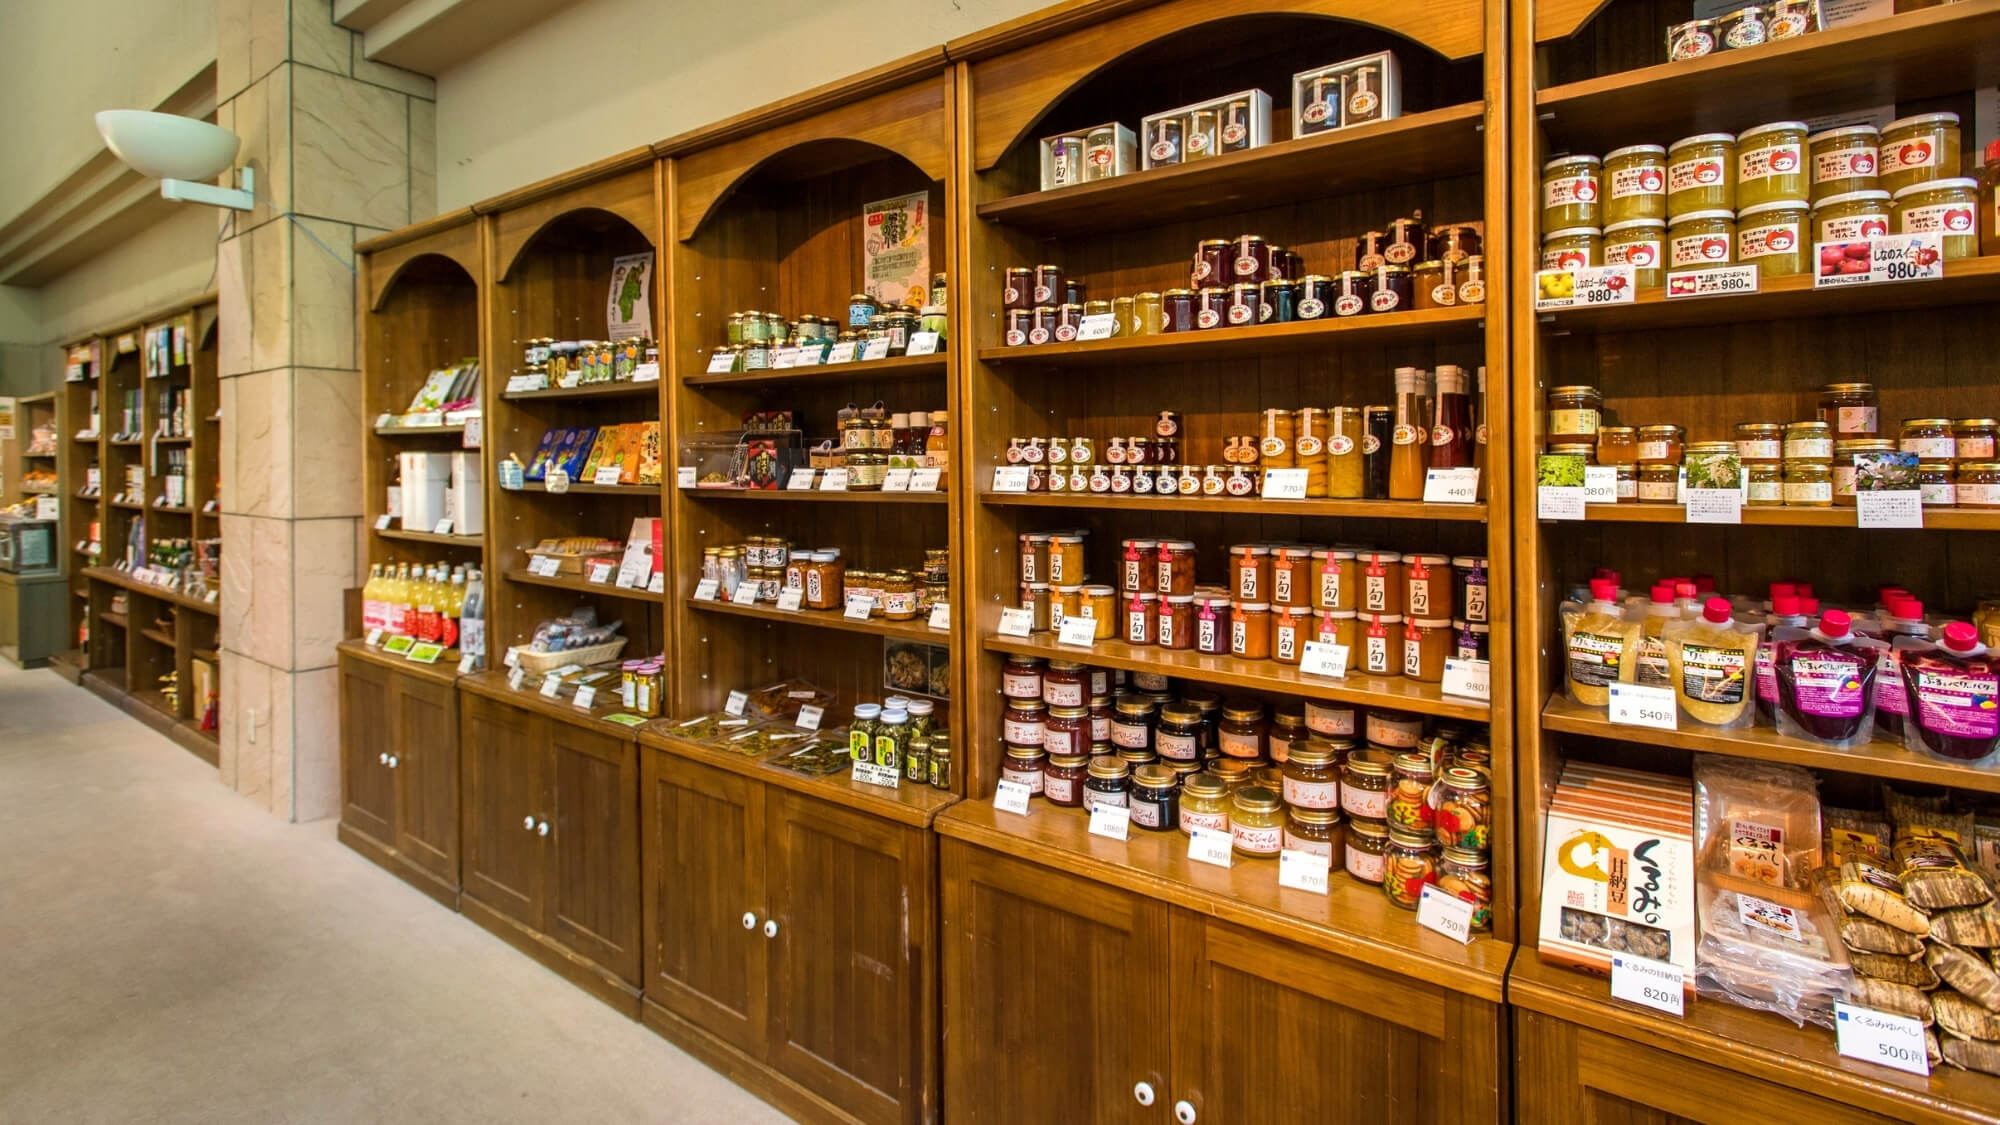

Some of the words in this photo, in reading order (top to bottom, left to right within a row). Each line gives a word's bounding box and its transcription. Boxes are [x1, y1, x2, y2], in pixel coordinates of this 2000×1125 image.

[1056, 166, 1065, 177] 旬
[1584, 486, 1614, 497] 080円
[1128, 570, 1139, 584] 旬
[1160, 572, 1171, 586] 旬
[1243, 578, 1256, 591] 旬
[1278, 581, 1290, 594] 旬
[1324, 586, 1338, 600] 旬
[1369, 588, 1384, 604] 旬
[1412, 592, 1427, 608] 旬
[1468, 598, 1485, 614] 旬
[1132, 621, 1144, 636] 旬
[1201, 630, 1214, 645] 旬
[1281, 638, 1293, 652] 旬
[1370, 649, 1385, 665] 旬
[1407, 652, 1418, 668] 旬
[1466, 681, 1488, 693] 980
[1639, 709, 1673, 722] 540円
[1609, 856, 1628, 905] 甘納豆
[1633, 839, 1662, 925] くるみの
[1643, 986, 1680, 1007] 820円
[1854, 1015, 1919, 1037] くるみゆべし
[1878, 1043, 1923, 1065] 500円
